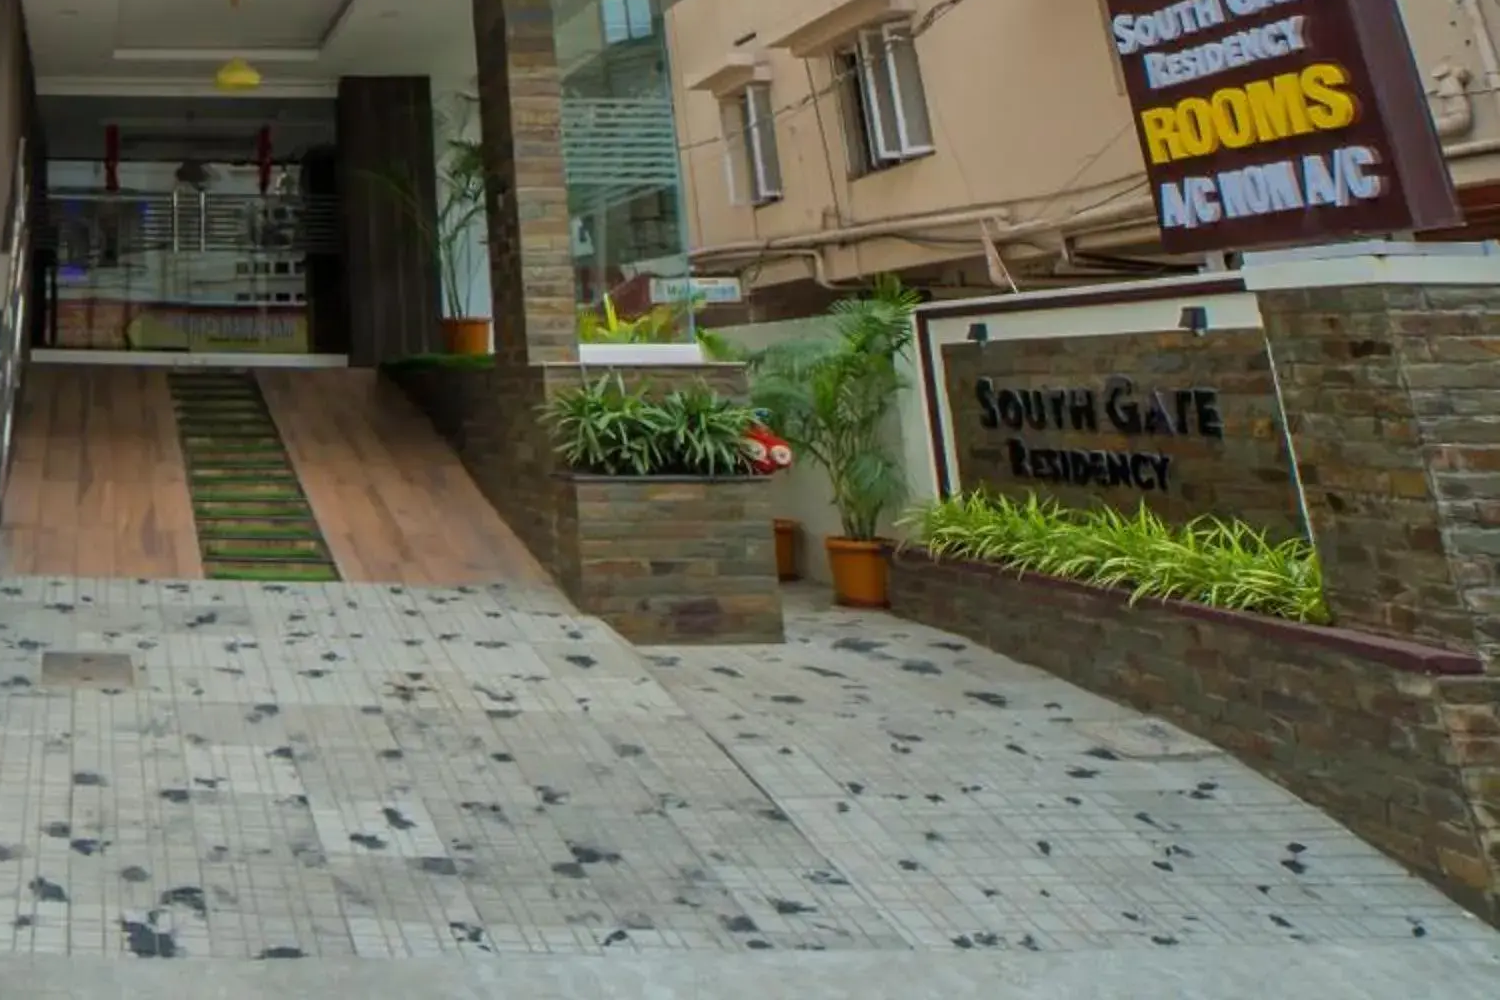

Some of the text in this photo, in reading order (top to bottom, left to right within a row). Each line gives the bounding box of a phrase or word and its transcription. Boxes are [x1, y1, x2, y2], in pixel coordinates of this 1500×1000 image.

[1144, 16, 1308, 89] RESIDENCY
[1141, 63, 1354, 164] ROOMS
[1160, 146, 1382, 229] A/C NON A/C
[975, 373, 1223, 440] SOUTH GATE
[1006, 438, 1171, 491] RESIDENCY
